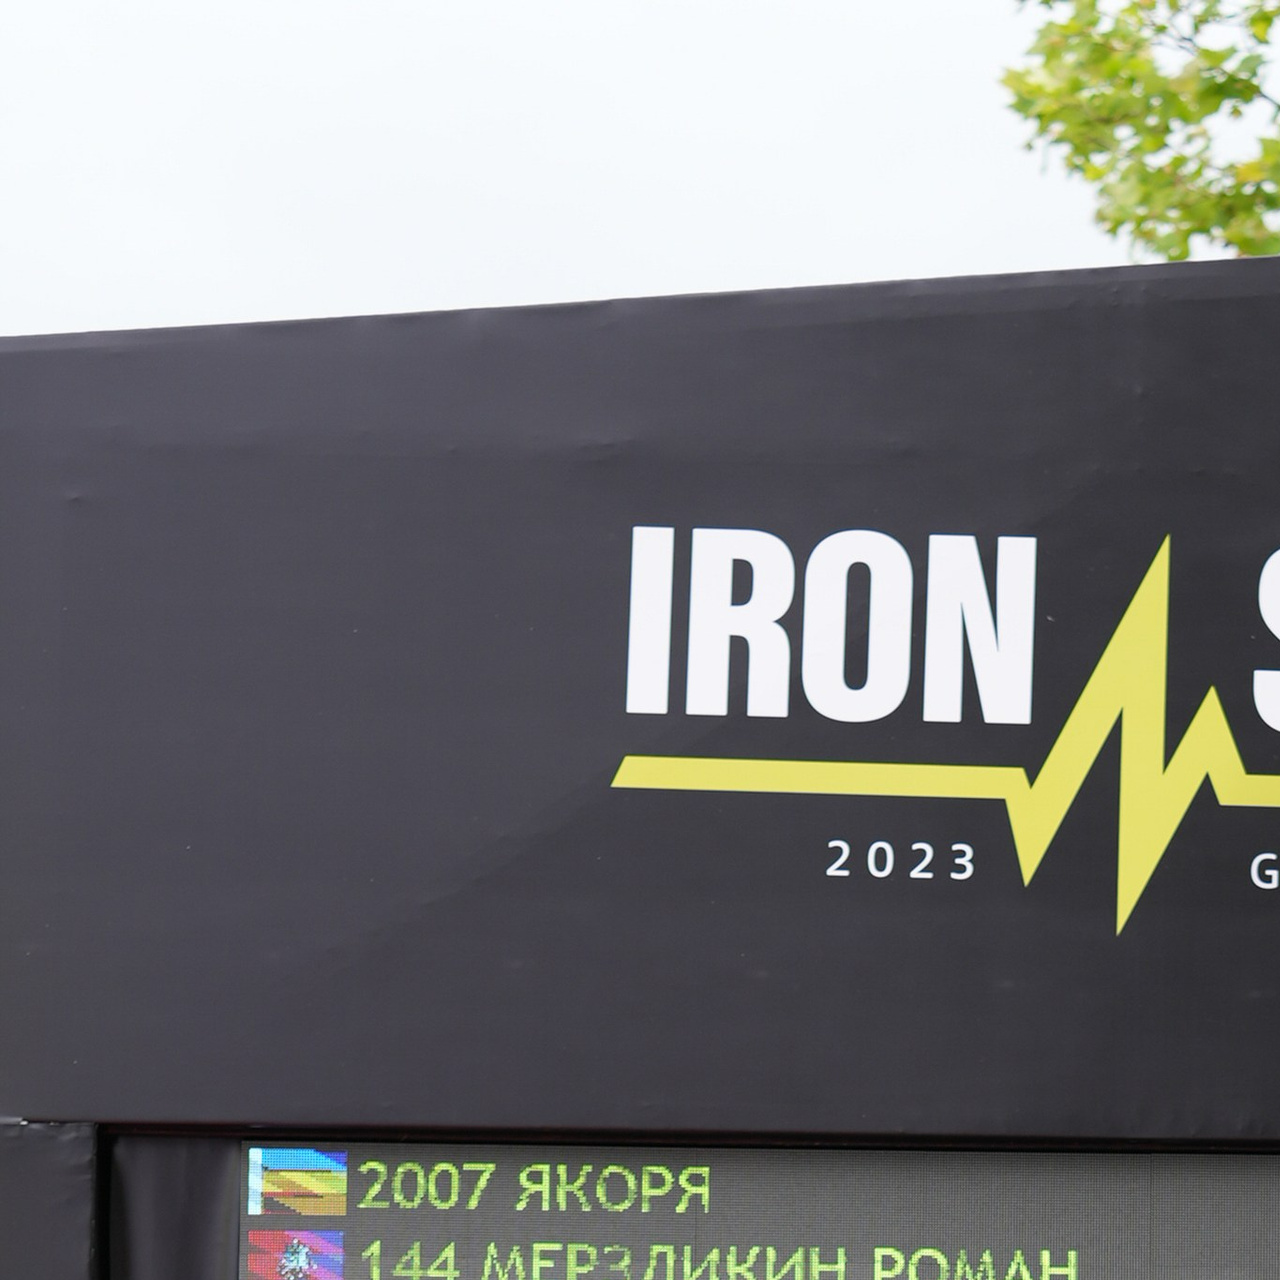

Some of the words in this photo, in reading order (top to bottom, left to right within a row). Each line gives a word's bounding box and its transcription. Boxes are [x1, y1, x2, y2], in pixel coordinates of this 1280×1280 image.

[626, 526, 1037, 725] IRON
[826, 840, 975, 880] 2023
[358, 1161, 496, 1210] 2007
[515, 1163, 711, 1214] ЯКОРЯ
